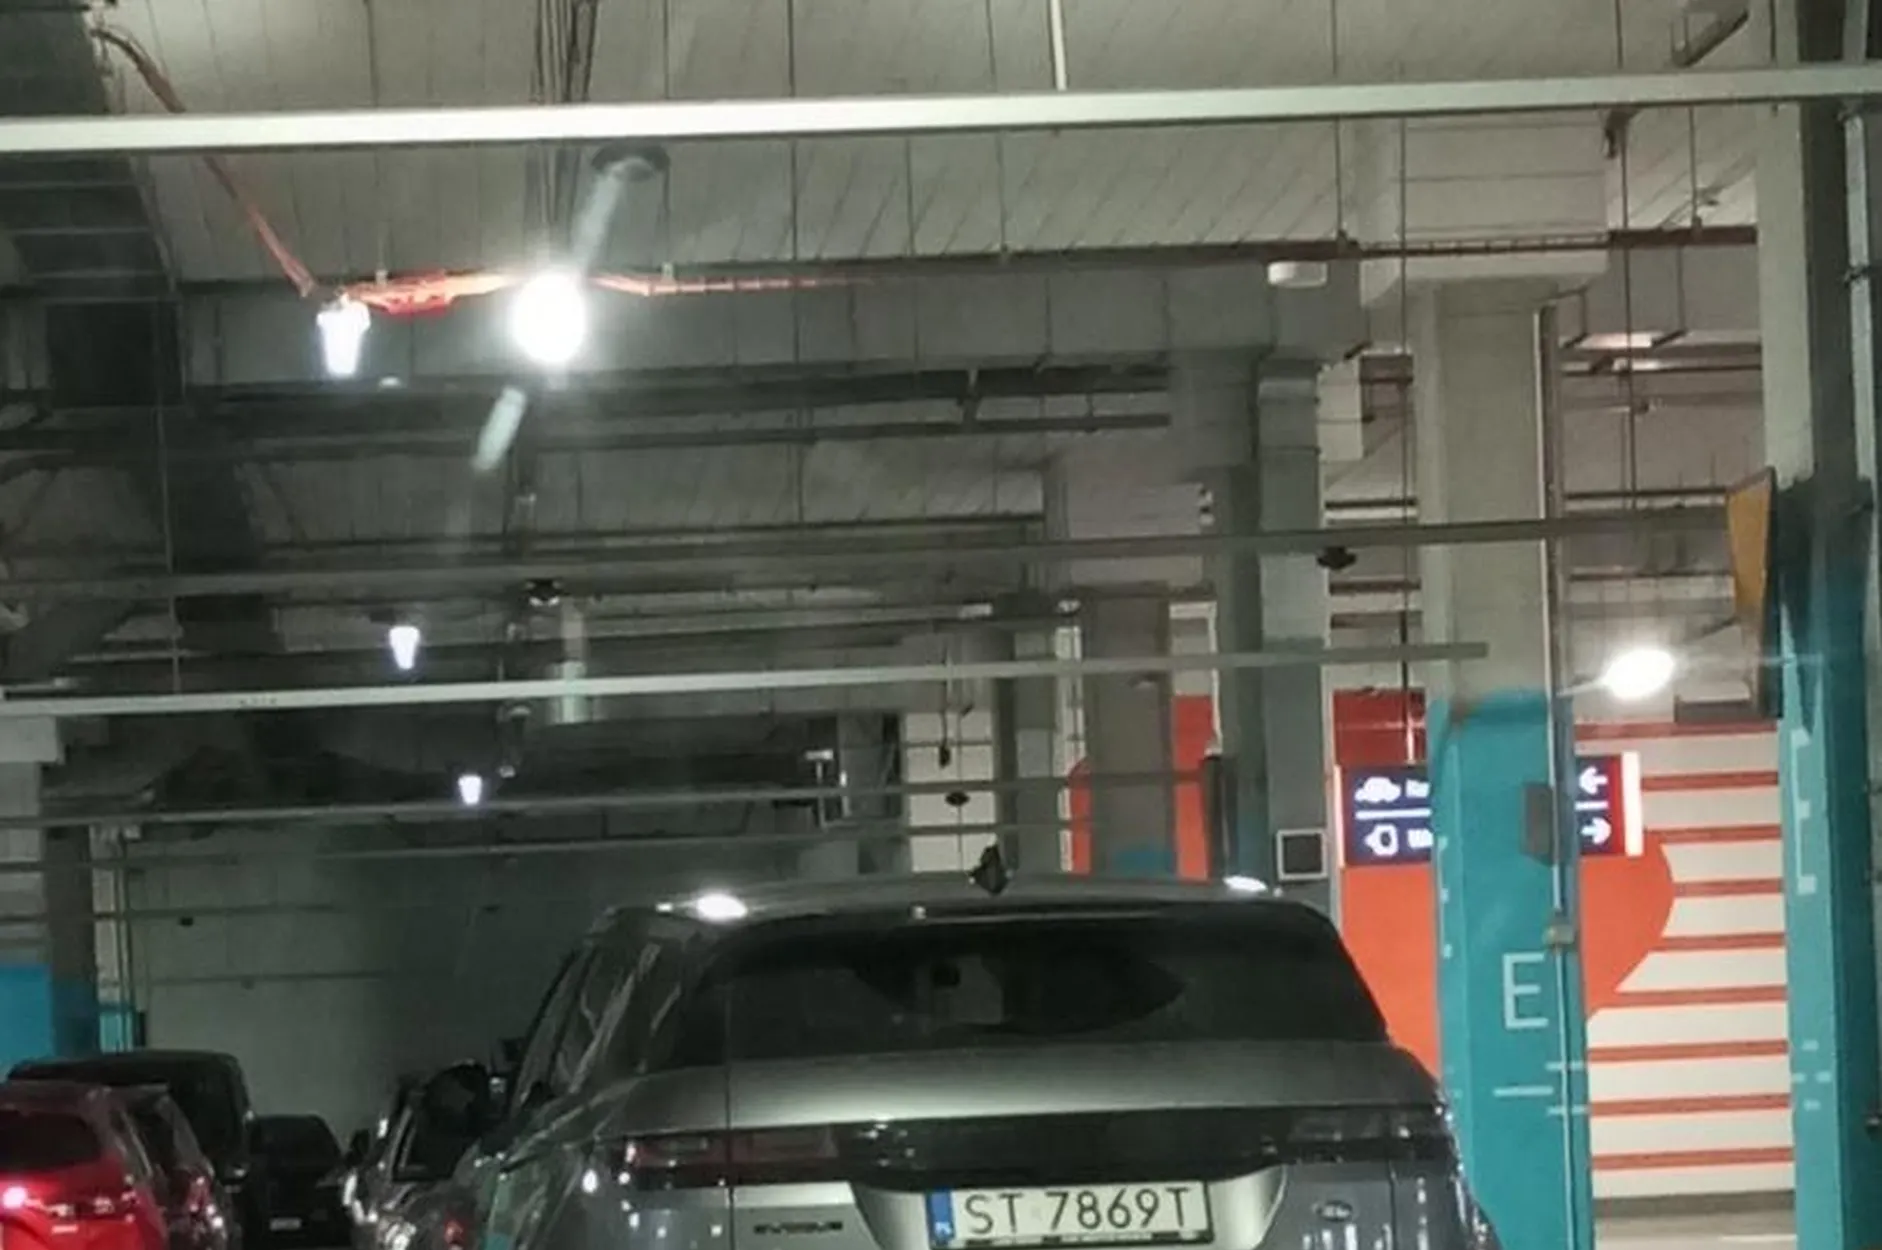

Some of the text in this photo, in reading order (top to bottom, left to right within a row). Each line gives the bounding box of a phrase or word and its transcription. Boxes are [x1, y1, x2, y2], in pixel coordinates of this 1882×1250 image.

[1502, 952, 1549, 1029] E
[964, 1187, 1191, 1234] ST 7869T
